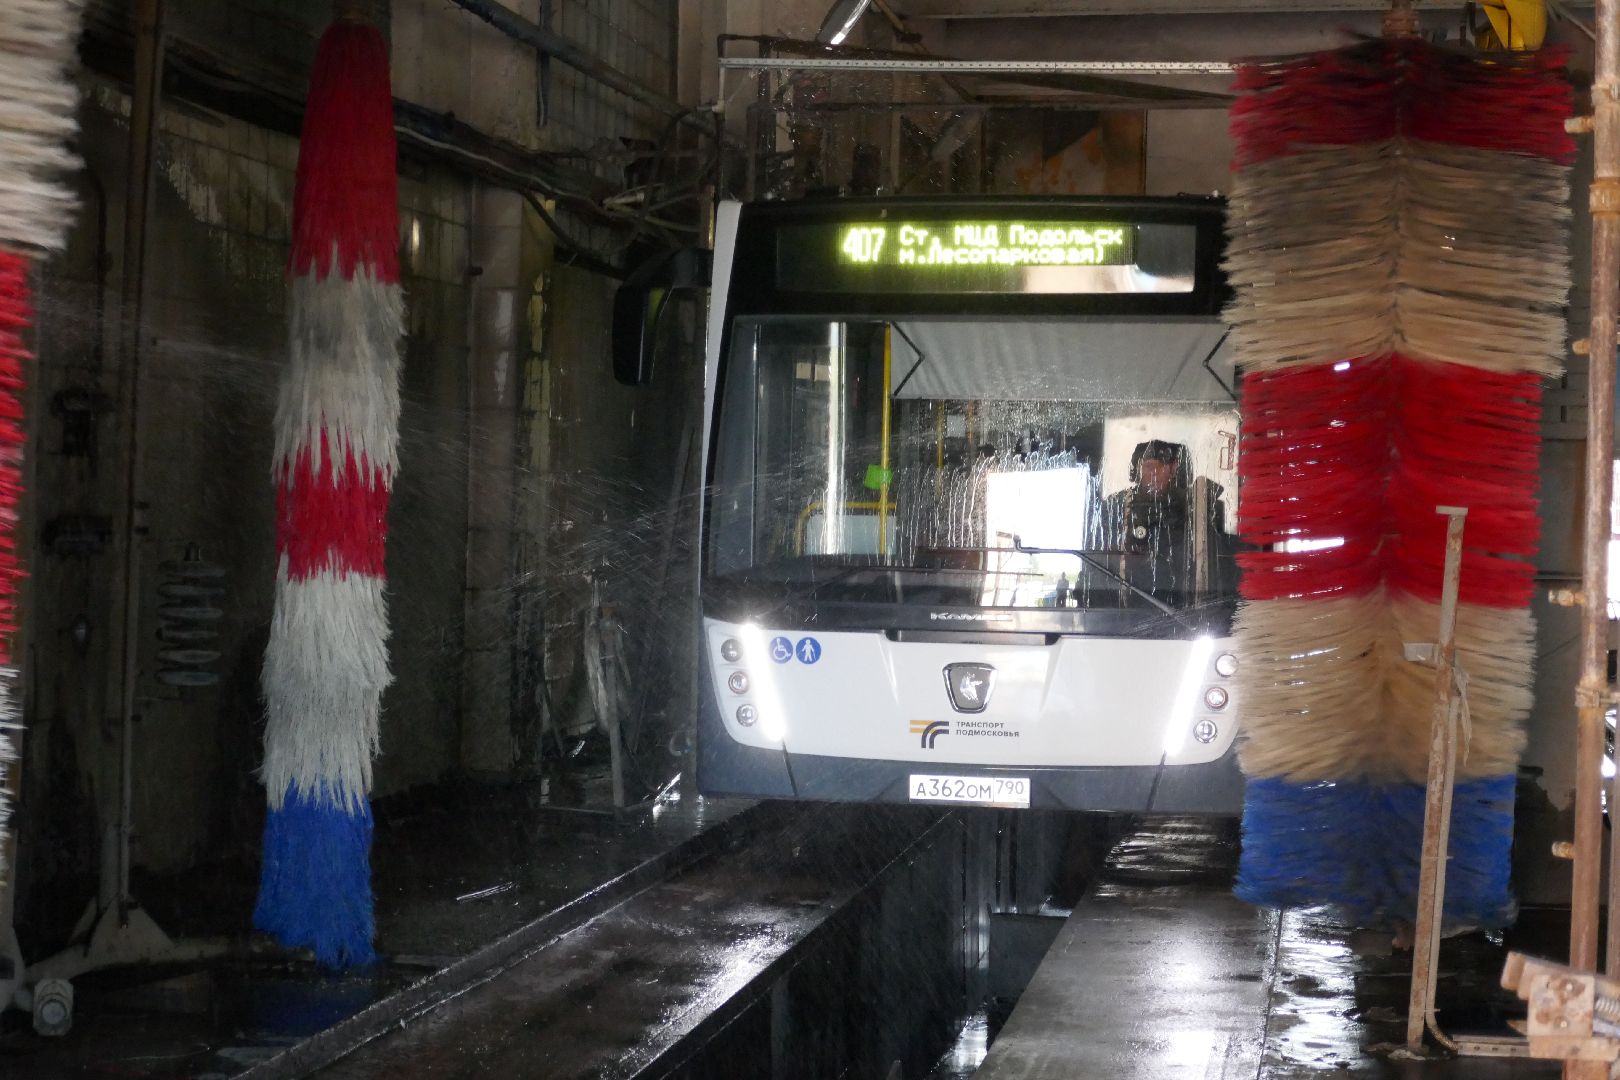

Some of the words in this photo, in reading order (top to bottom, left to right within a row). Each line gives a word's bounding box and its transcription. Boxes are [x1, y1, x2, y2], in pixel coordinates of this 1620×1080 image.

[842, 227, 886, 262] 407
[955, 225, 998, 247] МЦД
[1010, 225, 1123, 248] Подольск
[956, 720, 1005, 730] ТРАНСПОРТ
[956, 729, 1020, 738] ПОДМОСКОВЬЯ
[996, 779, 1025, 795] 790
